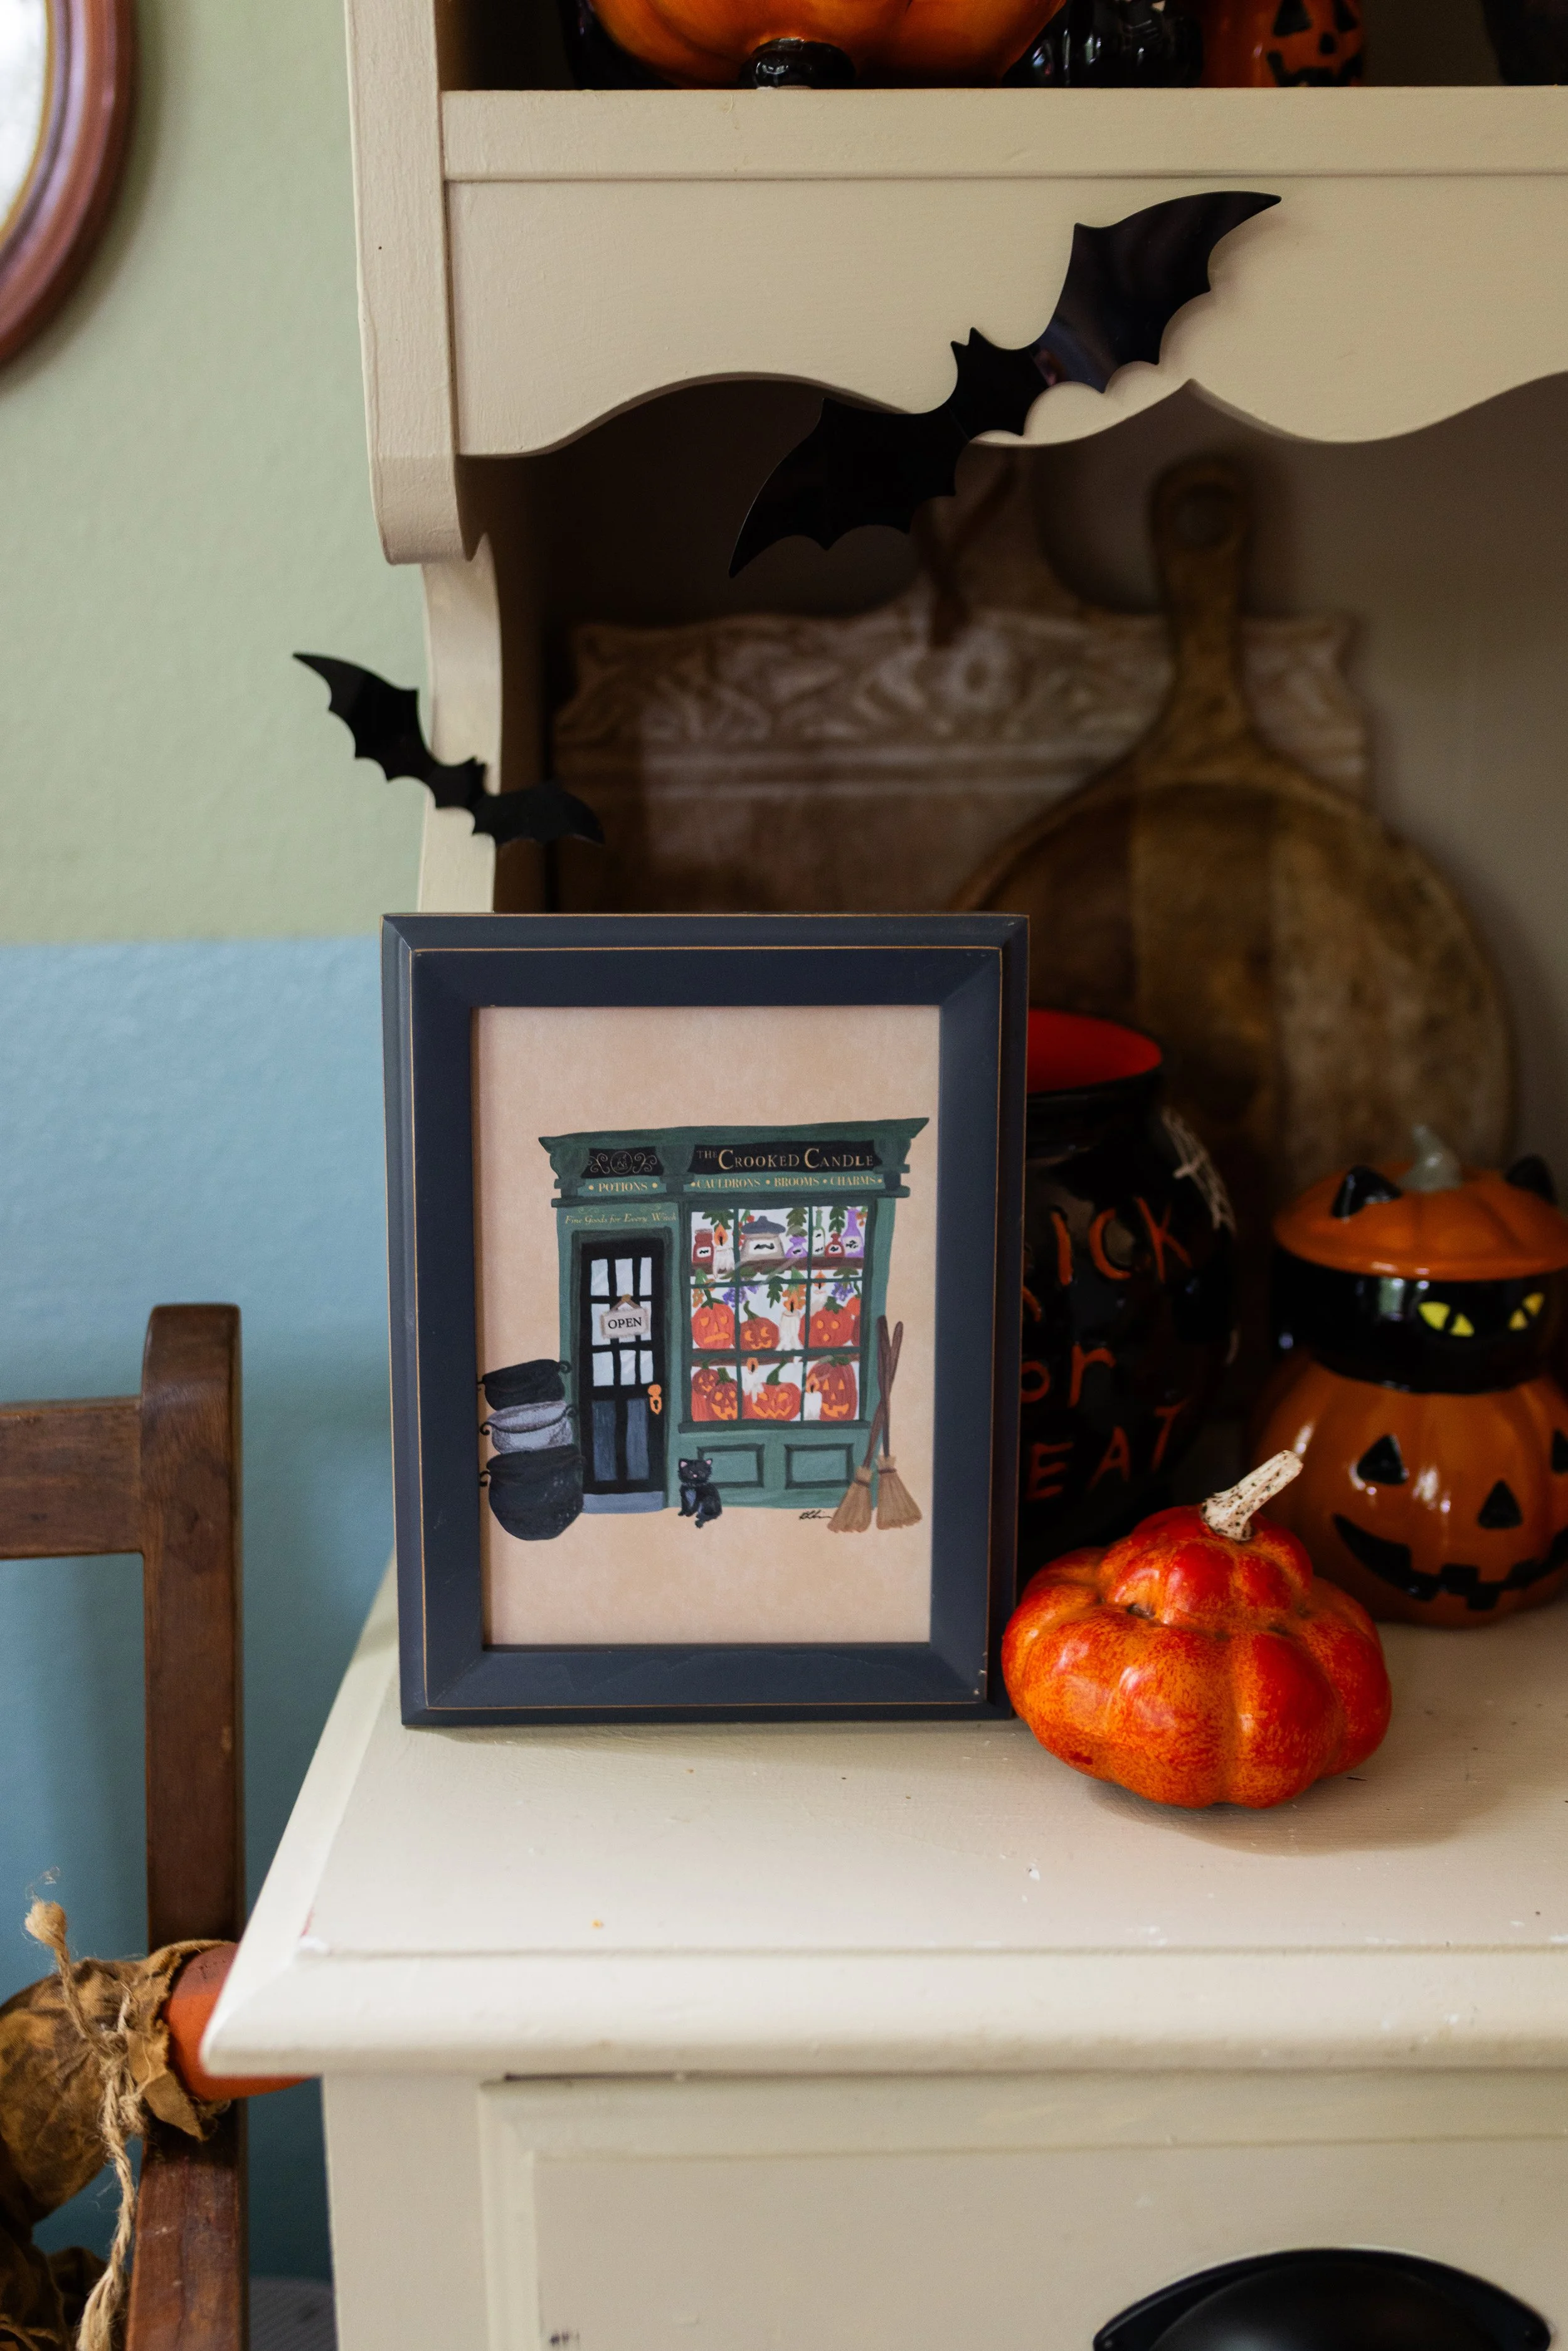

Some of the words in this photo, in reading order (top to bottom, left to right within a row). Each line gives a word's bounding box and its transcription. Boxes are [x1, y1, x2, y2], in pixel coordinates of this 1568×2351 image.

[696, 1150, 718, 1159] THE
[718, 1149, 800, 1170] CROOKED
[804, 1148, 874, 1169] CANDLE
[598, 1182, 648, 1192] POTIONS
[697, 1178, 761, 1189] CAULDRONS
[774, 1176, 819, 1187] BROOMS
[830, 1176, 876, 1186] CHARMS
[565, 1215, 582, 1224] Fine
[609, 1215, 621, 1224] for
[624, 1213, 647, 1223] Every
[1022, 1194, 1193, 1322] ICK
[608, 1317, 642, 1329] OPEN
[1025, 1398, 1190, 1500] EAT
